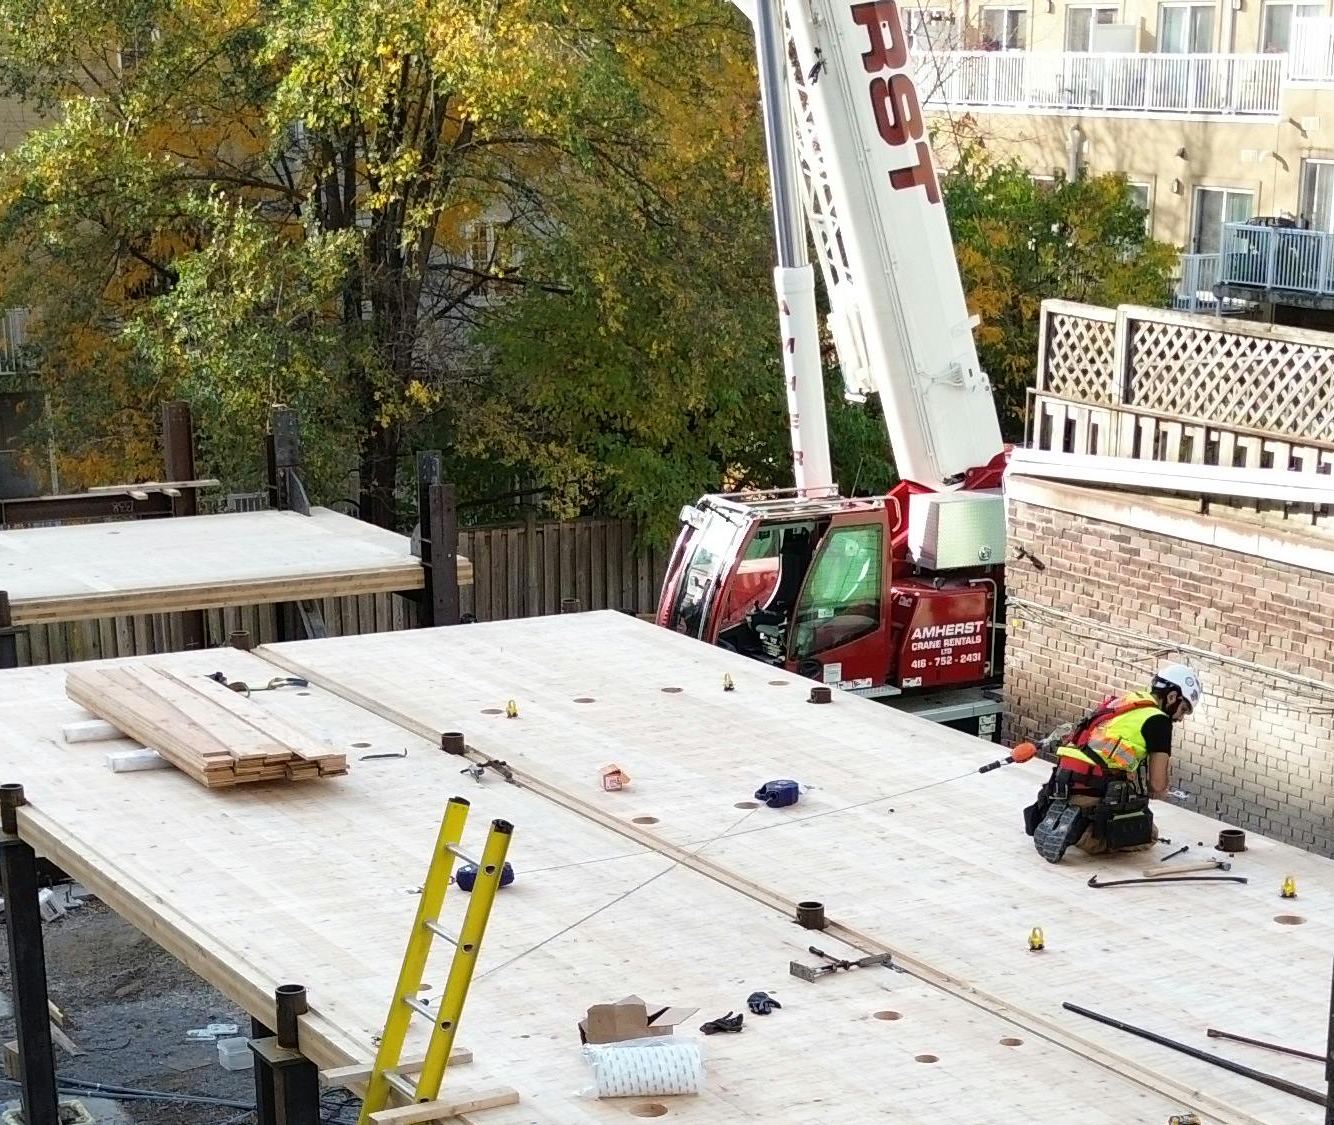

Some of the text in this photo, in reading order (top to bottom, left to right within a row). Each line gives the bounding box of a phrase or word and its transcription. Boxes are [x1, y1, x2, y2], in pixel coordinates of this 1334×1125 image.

[911, 621, 984, 640] AMHERST
[911, 635, 982, 652] CRANE RENTALS
[940, 647, 953, 656] LTD
[934, 655, 953, 667] 752
